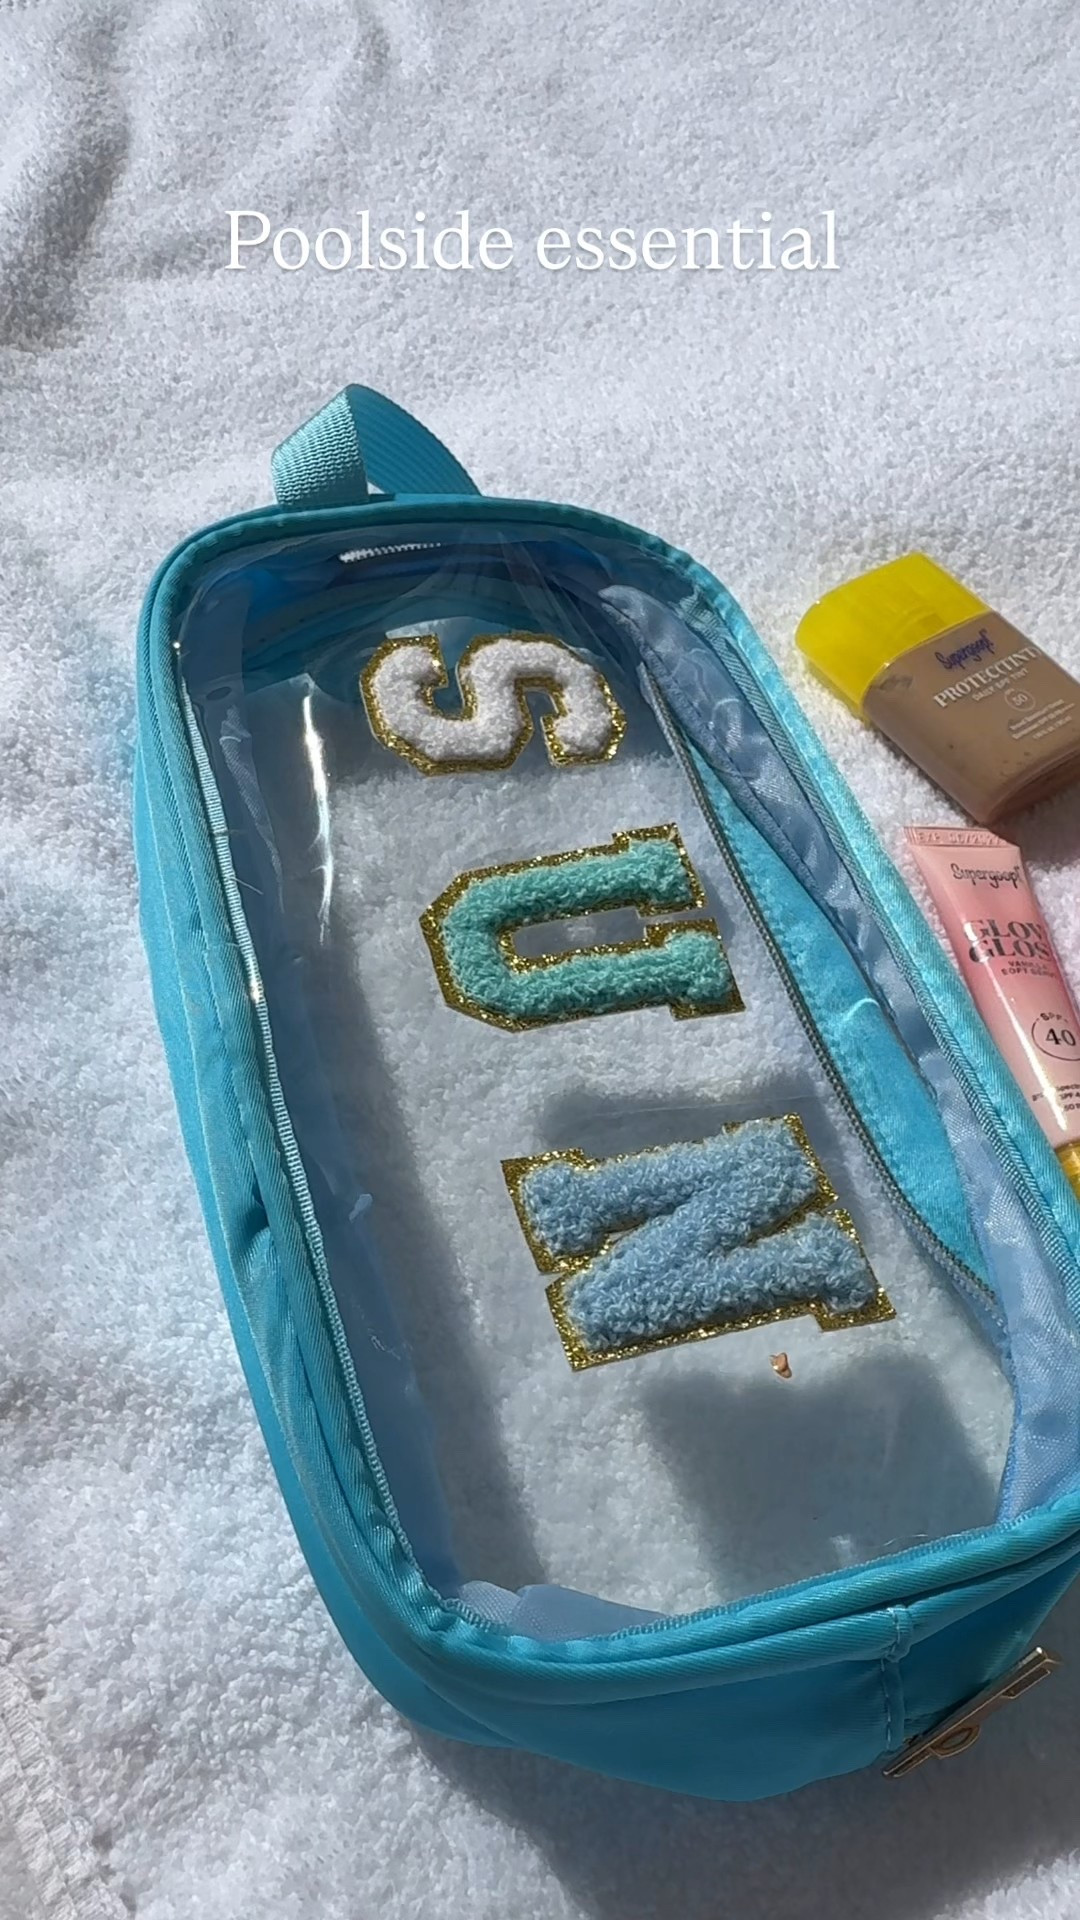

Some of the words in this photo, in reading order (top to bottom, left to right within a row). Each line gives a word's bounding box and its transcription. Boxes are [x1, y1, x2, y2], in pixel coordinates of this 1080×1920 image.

[968, 938, 1053, 963] GLOS
[1001, 967, 1028, 976] SOFT
[1045, 1028, 1077, 1047] 40
